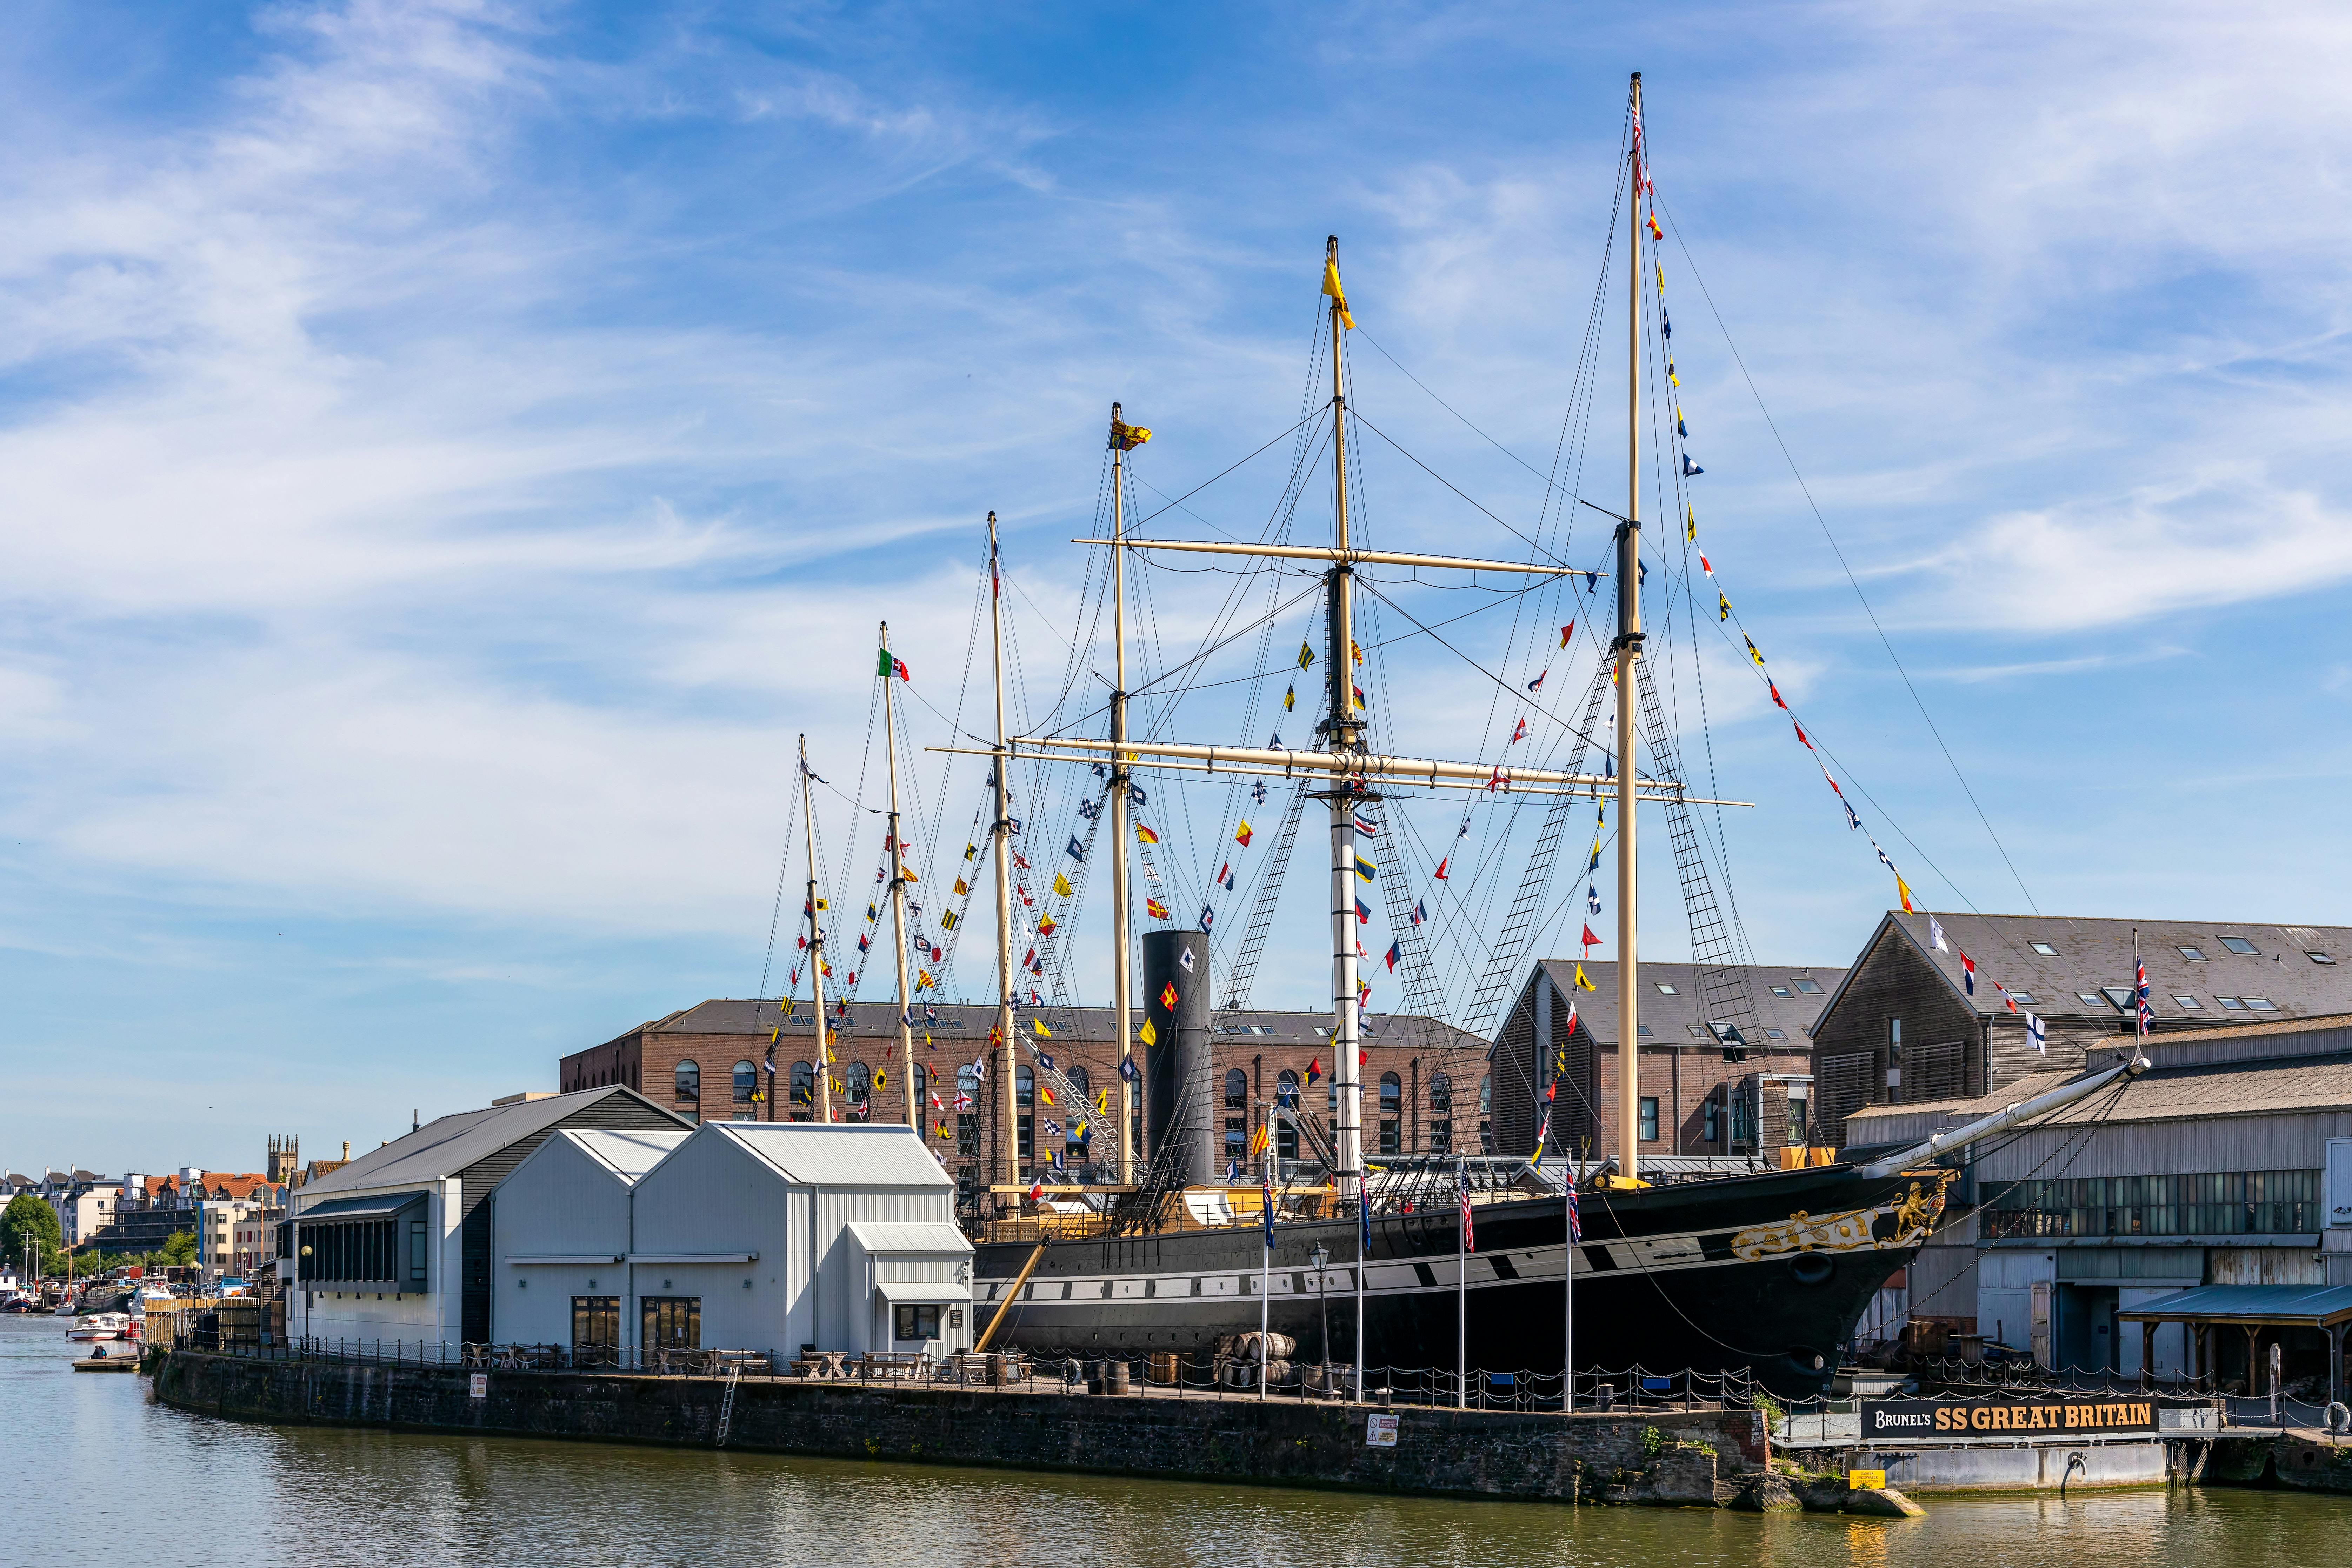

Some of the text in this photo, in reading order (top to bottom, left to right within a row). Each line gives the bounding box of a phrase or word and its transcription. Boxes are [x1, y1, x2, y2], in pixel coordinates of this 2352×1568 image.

[1935, 1407, 1967, 1430] SS
[1971, 1406, 2061, 1429] GREAT
[2065, 1403, 2151, 1427] BRITAIN
